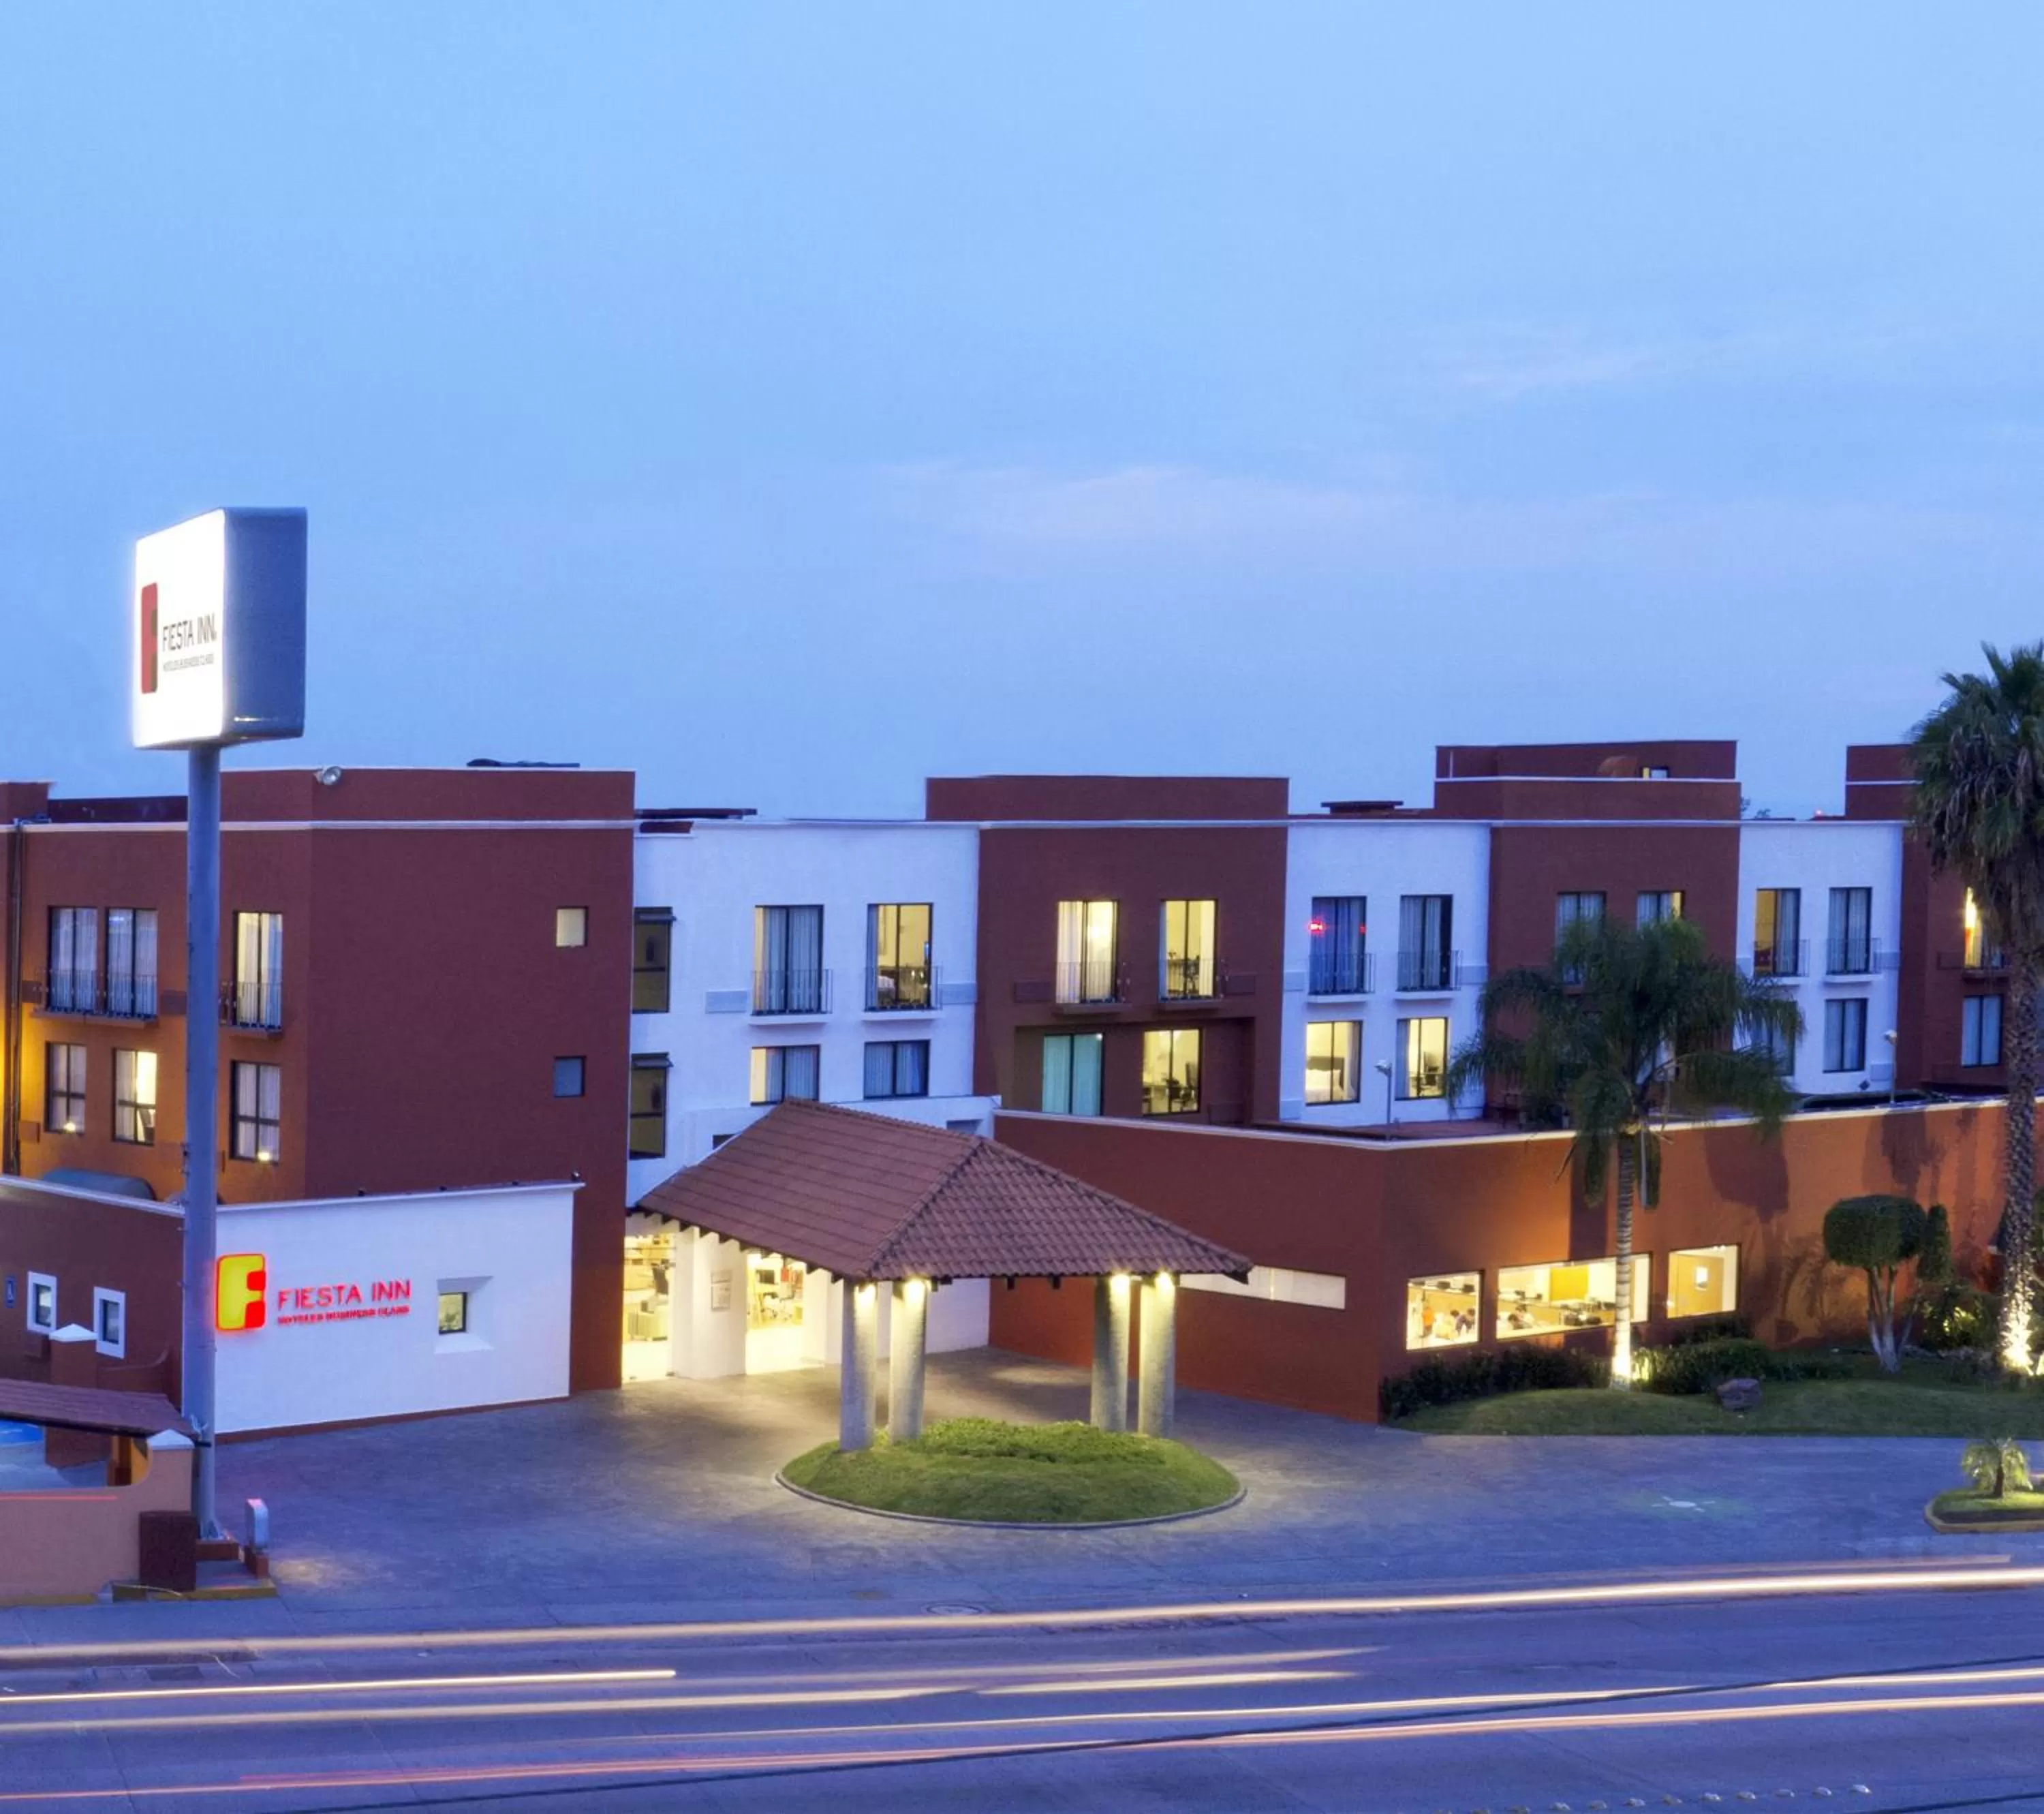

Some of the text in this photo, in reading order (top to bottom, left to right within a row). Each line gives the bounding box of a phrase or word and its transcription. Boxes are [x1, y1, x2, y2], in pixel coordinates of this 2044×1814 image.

[163, 613, 217, 652] FIESTA INN
[278, 1279, 411, 1311] FIESTA INN
